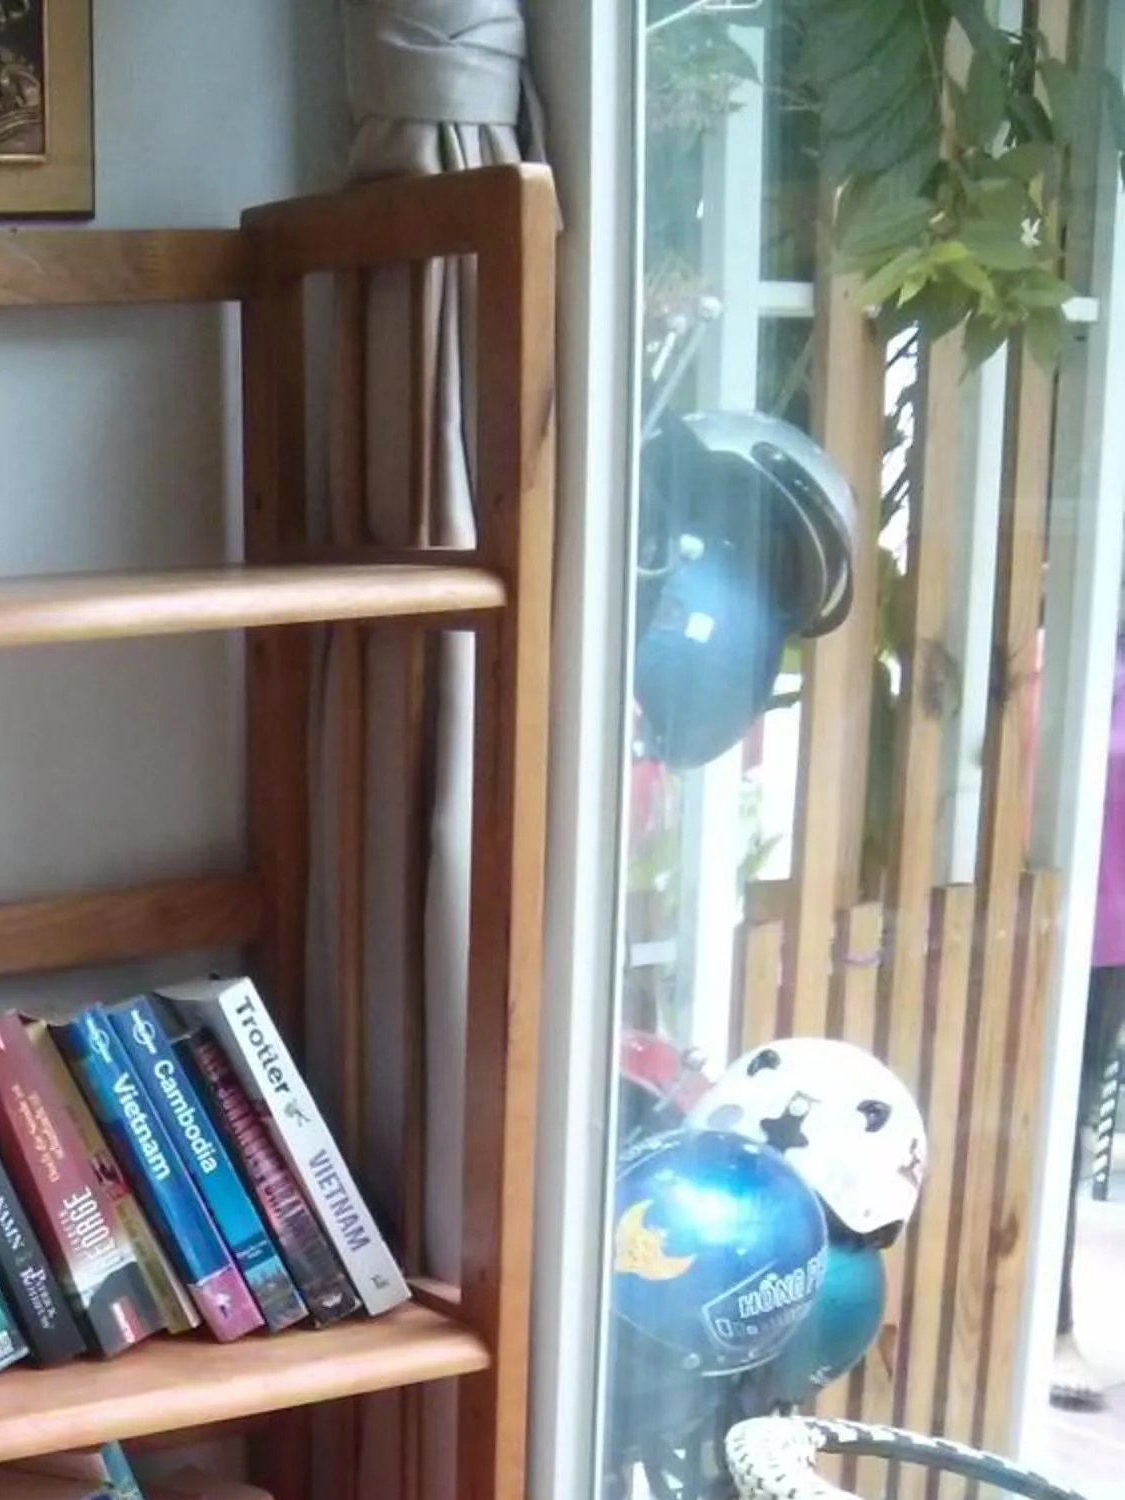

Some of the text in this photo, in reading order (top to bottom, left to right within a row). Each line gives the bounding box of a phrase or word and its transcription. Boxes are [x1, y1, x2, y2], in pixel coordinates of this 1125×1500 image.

[107, 1071, 176, 1183] Vietnam
[149, 1056, 222, 1175] Cambodia
[304, 1148, 372, 1253] VIETNAM
